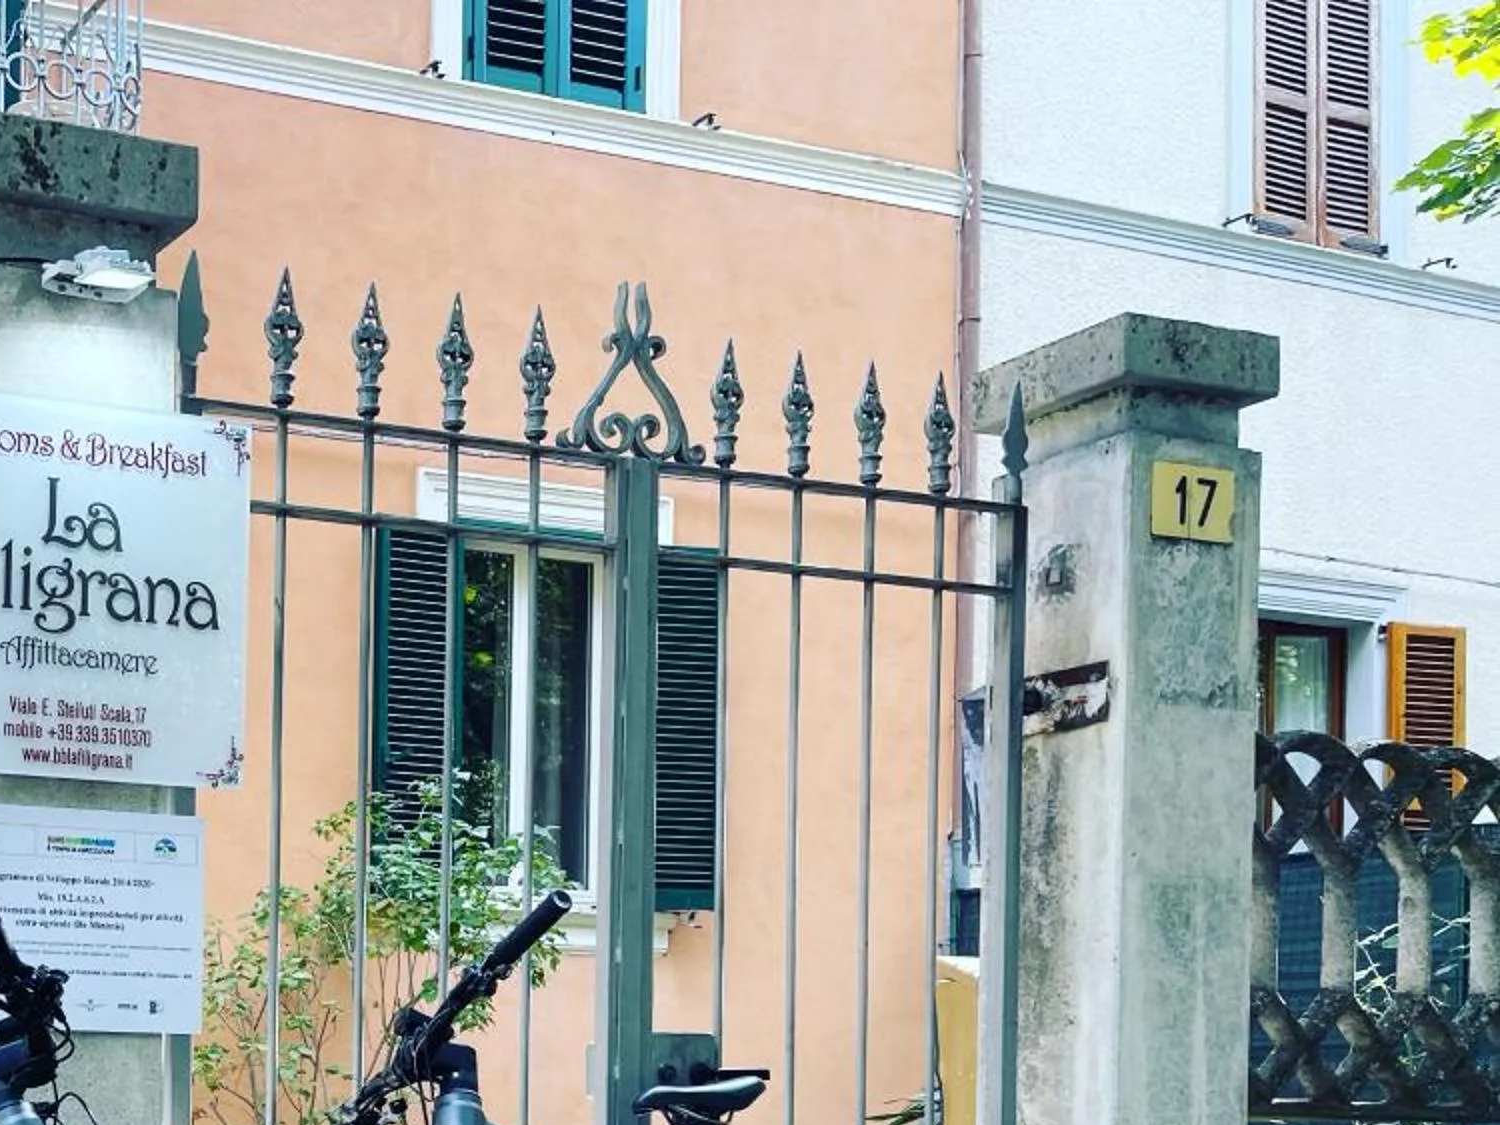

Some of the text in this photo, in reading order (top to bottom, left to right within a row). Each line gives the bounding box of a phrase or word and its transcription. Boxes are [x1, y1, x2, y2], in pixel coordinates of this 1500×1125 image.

[61, 429, 81, 461] &
[85, 432, 207, 479] Breakfast
[40, 477, 123, 553] La
[1175, 475, 1217, 528] 17
[0, 636, 159, 677] Affittacamere
[9, 695, 37, 715] Viale
[3, 720, 42, 739] mobile
